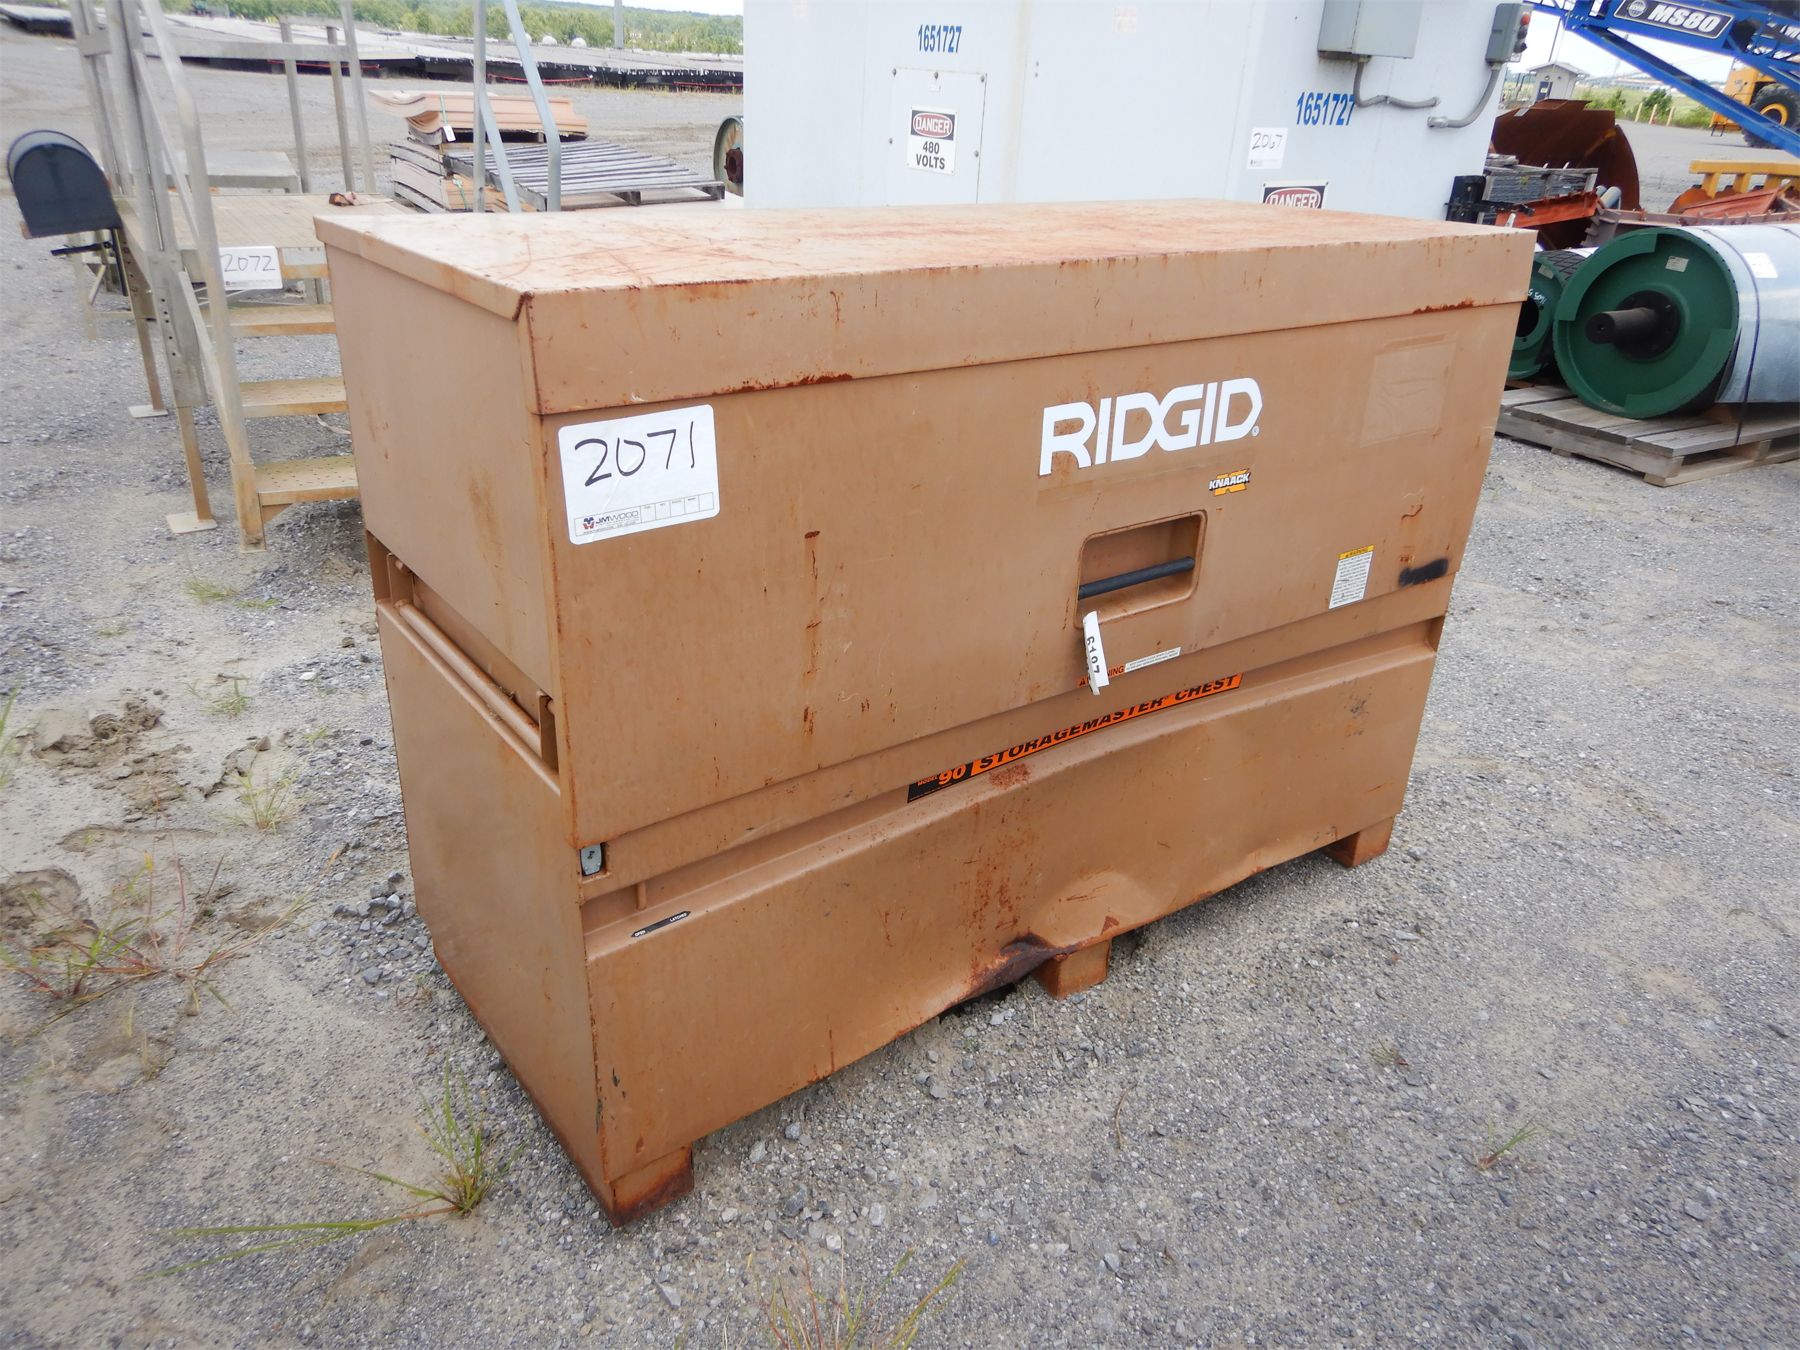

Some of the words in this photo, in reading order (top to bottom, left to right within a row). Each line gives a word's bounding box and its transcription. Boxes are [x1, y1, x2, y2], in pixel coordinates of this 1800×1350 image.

[1648, 4, 1721, 32] MS80
[917, 24, 962, 53] 1651727
[1296, 91, 1355, 126] 1651727
[915, 116, 951, 135] DANGER
[922, 140, 940, 154] 480
[1251, 132, 1283, 150] 2067
[916, 153, 946, 170] VOLTS
[220, 253, 276, 272] 2072
[1038, 377, 1264, 476] RIDGID
[574, 420, 696, 487] 2071
[1208, 472, 1251, 490] KNAACK
[938, 763, 967, 785] 90
[1174, 674, 1238, 701] CHEST
